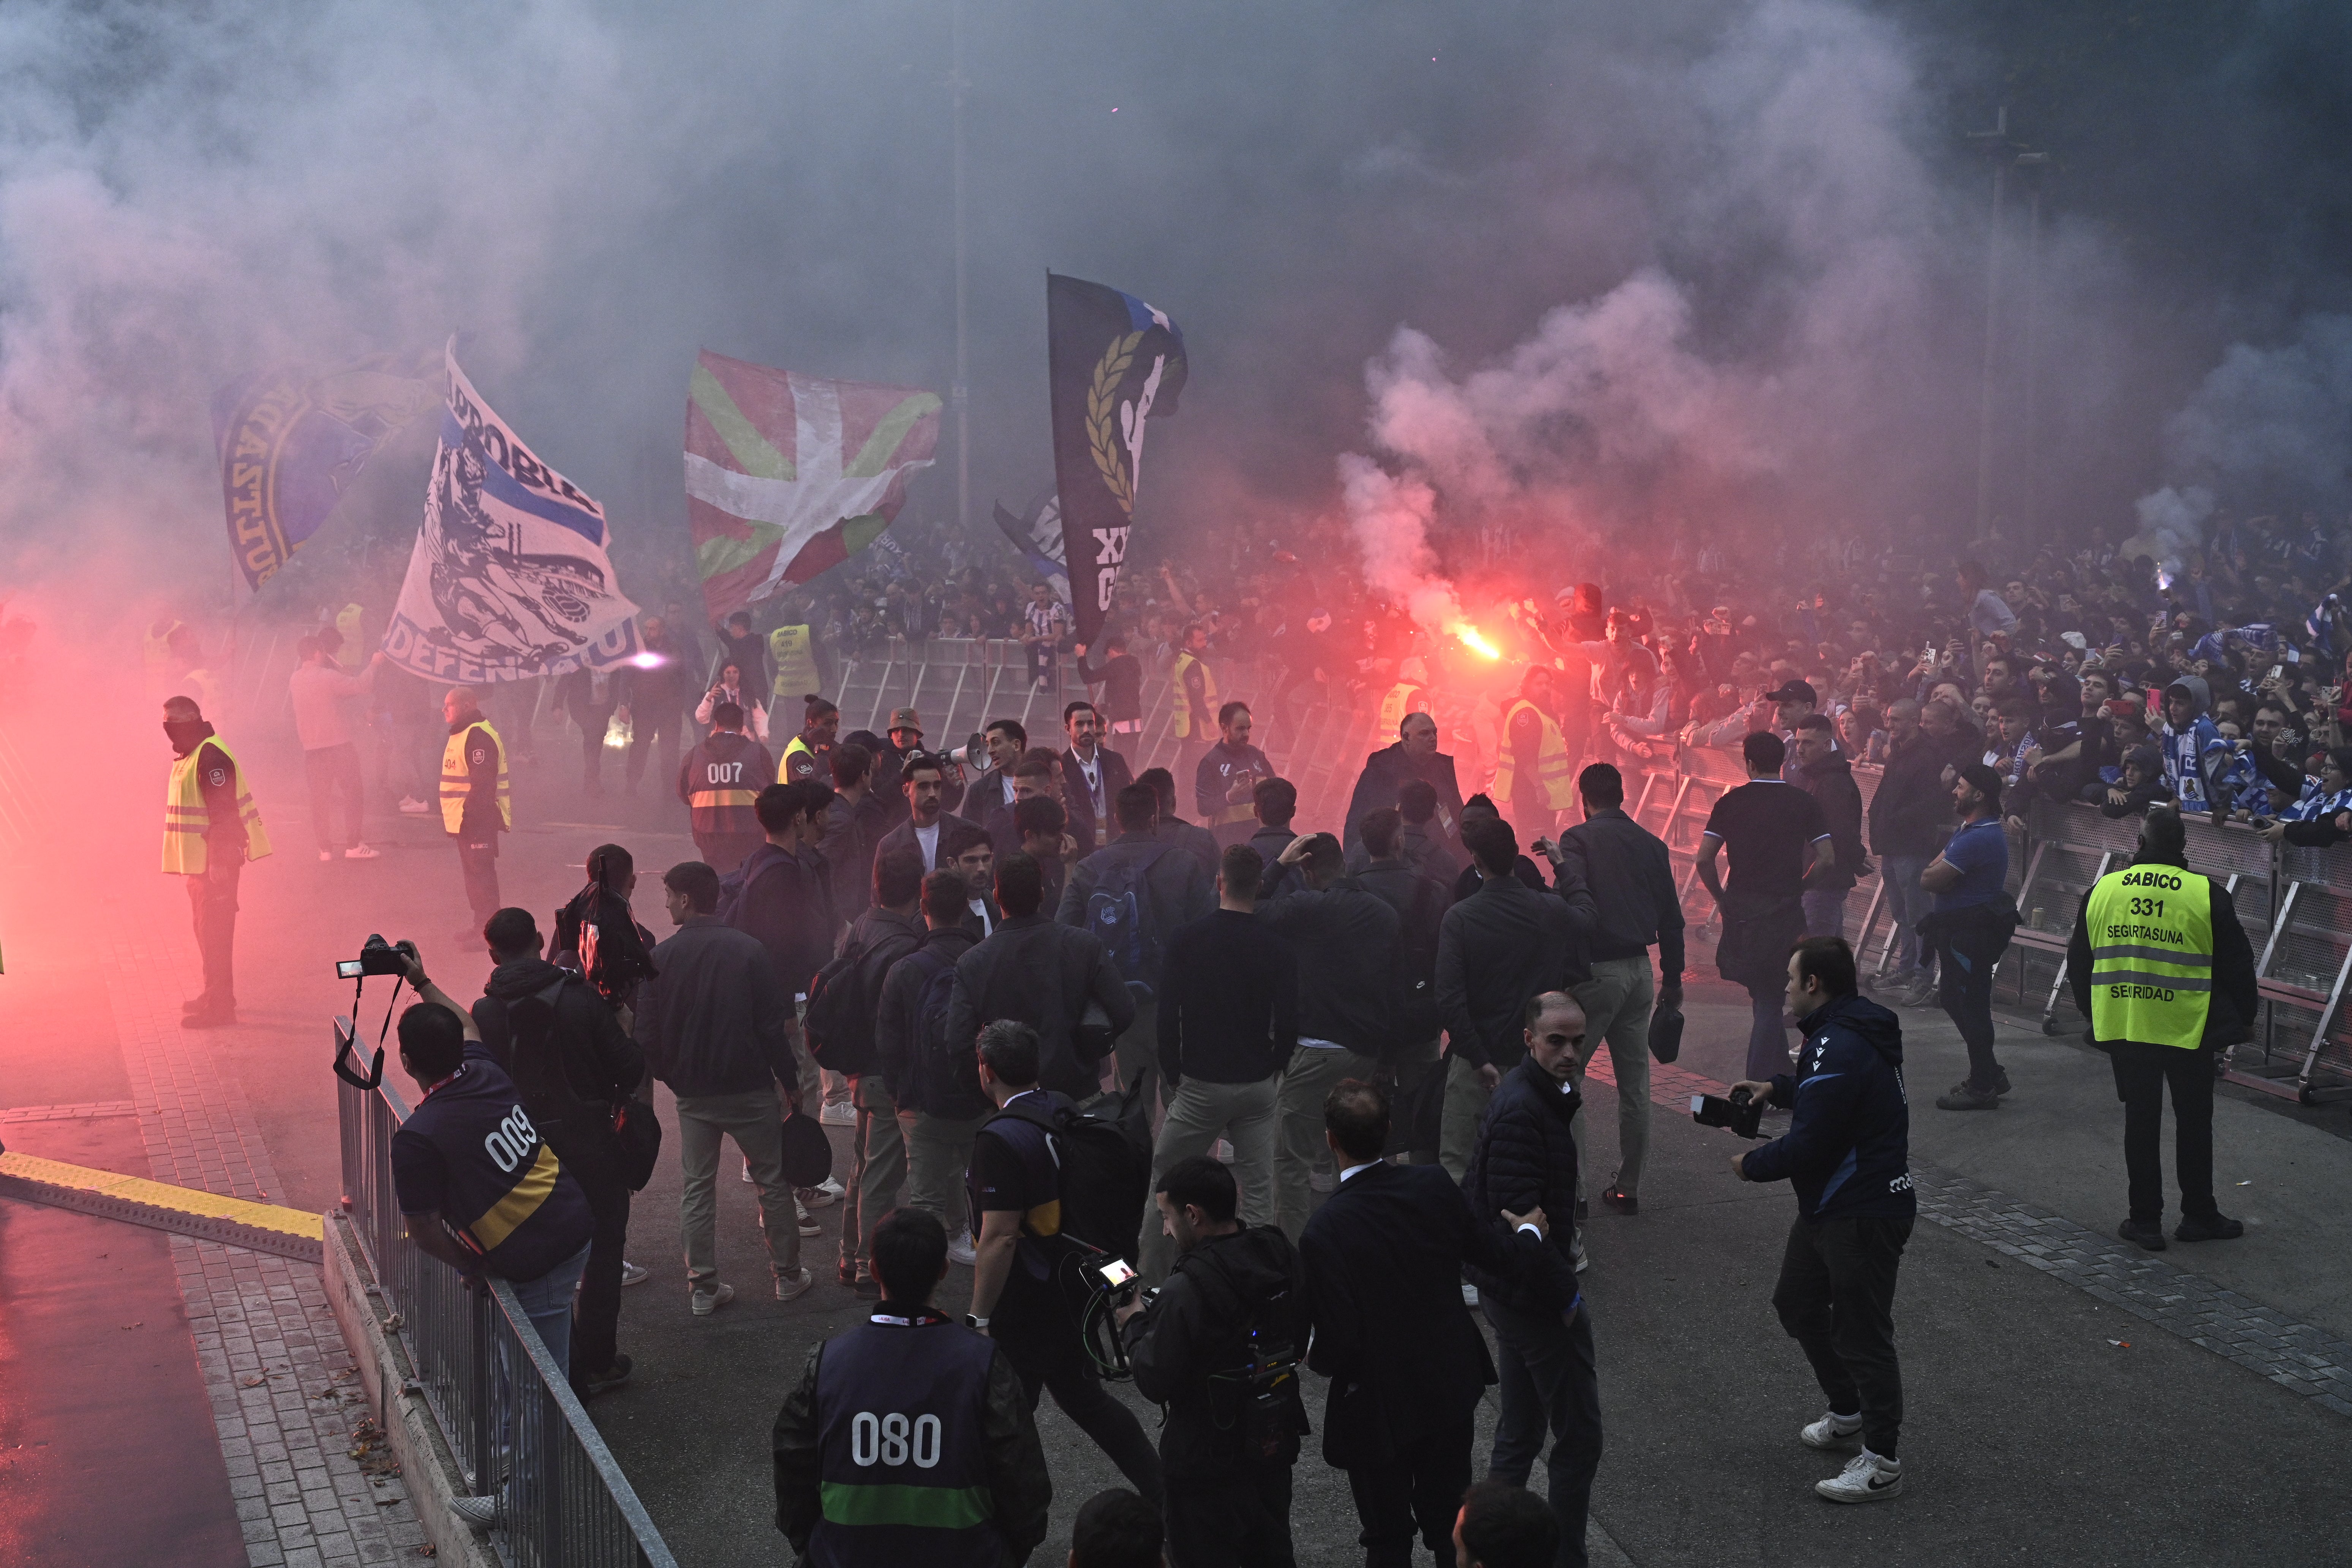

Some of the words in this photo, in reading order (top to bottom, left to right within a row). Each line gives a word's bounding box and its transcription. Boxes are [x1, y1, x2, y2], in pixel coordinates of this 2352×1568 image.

[444, 759, 456, 769] 404
[708, 763, 742, 784] 007
[2122, 872, 2182, 891] SABICO
[2130, 897, 2164, 918] 331
[485, 1105, 537, 1173] 009
[852, 1412, 941, 1468] 080
